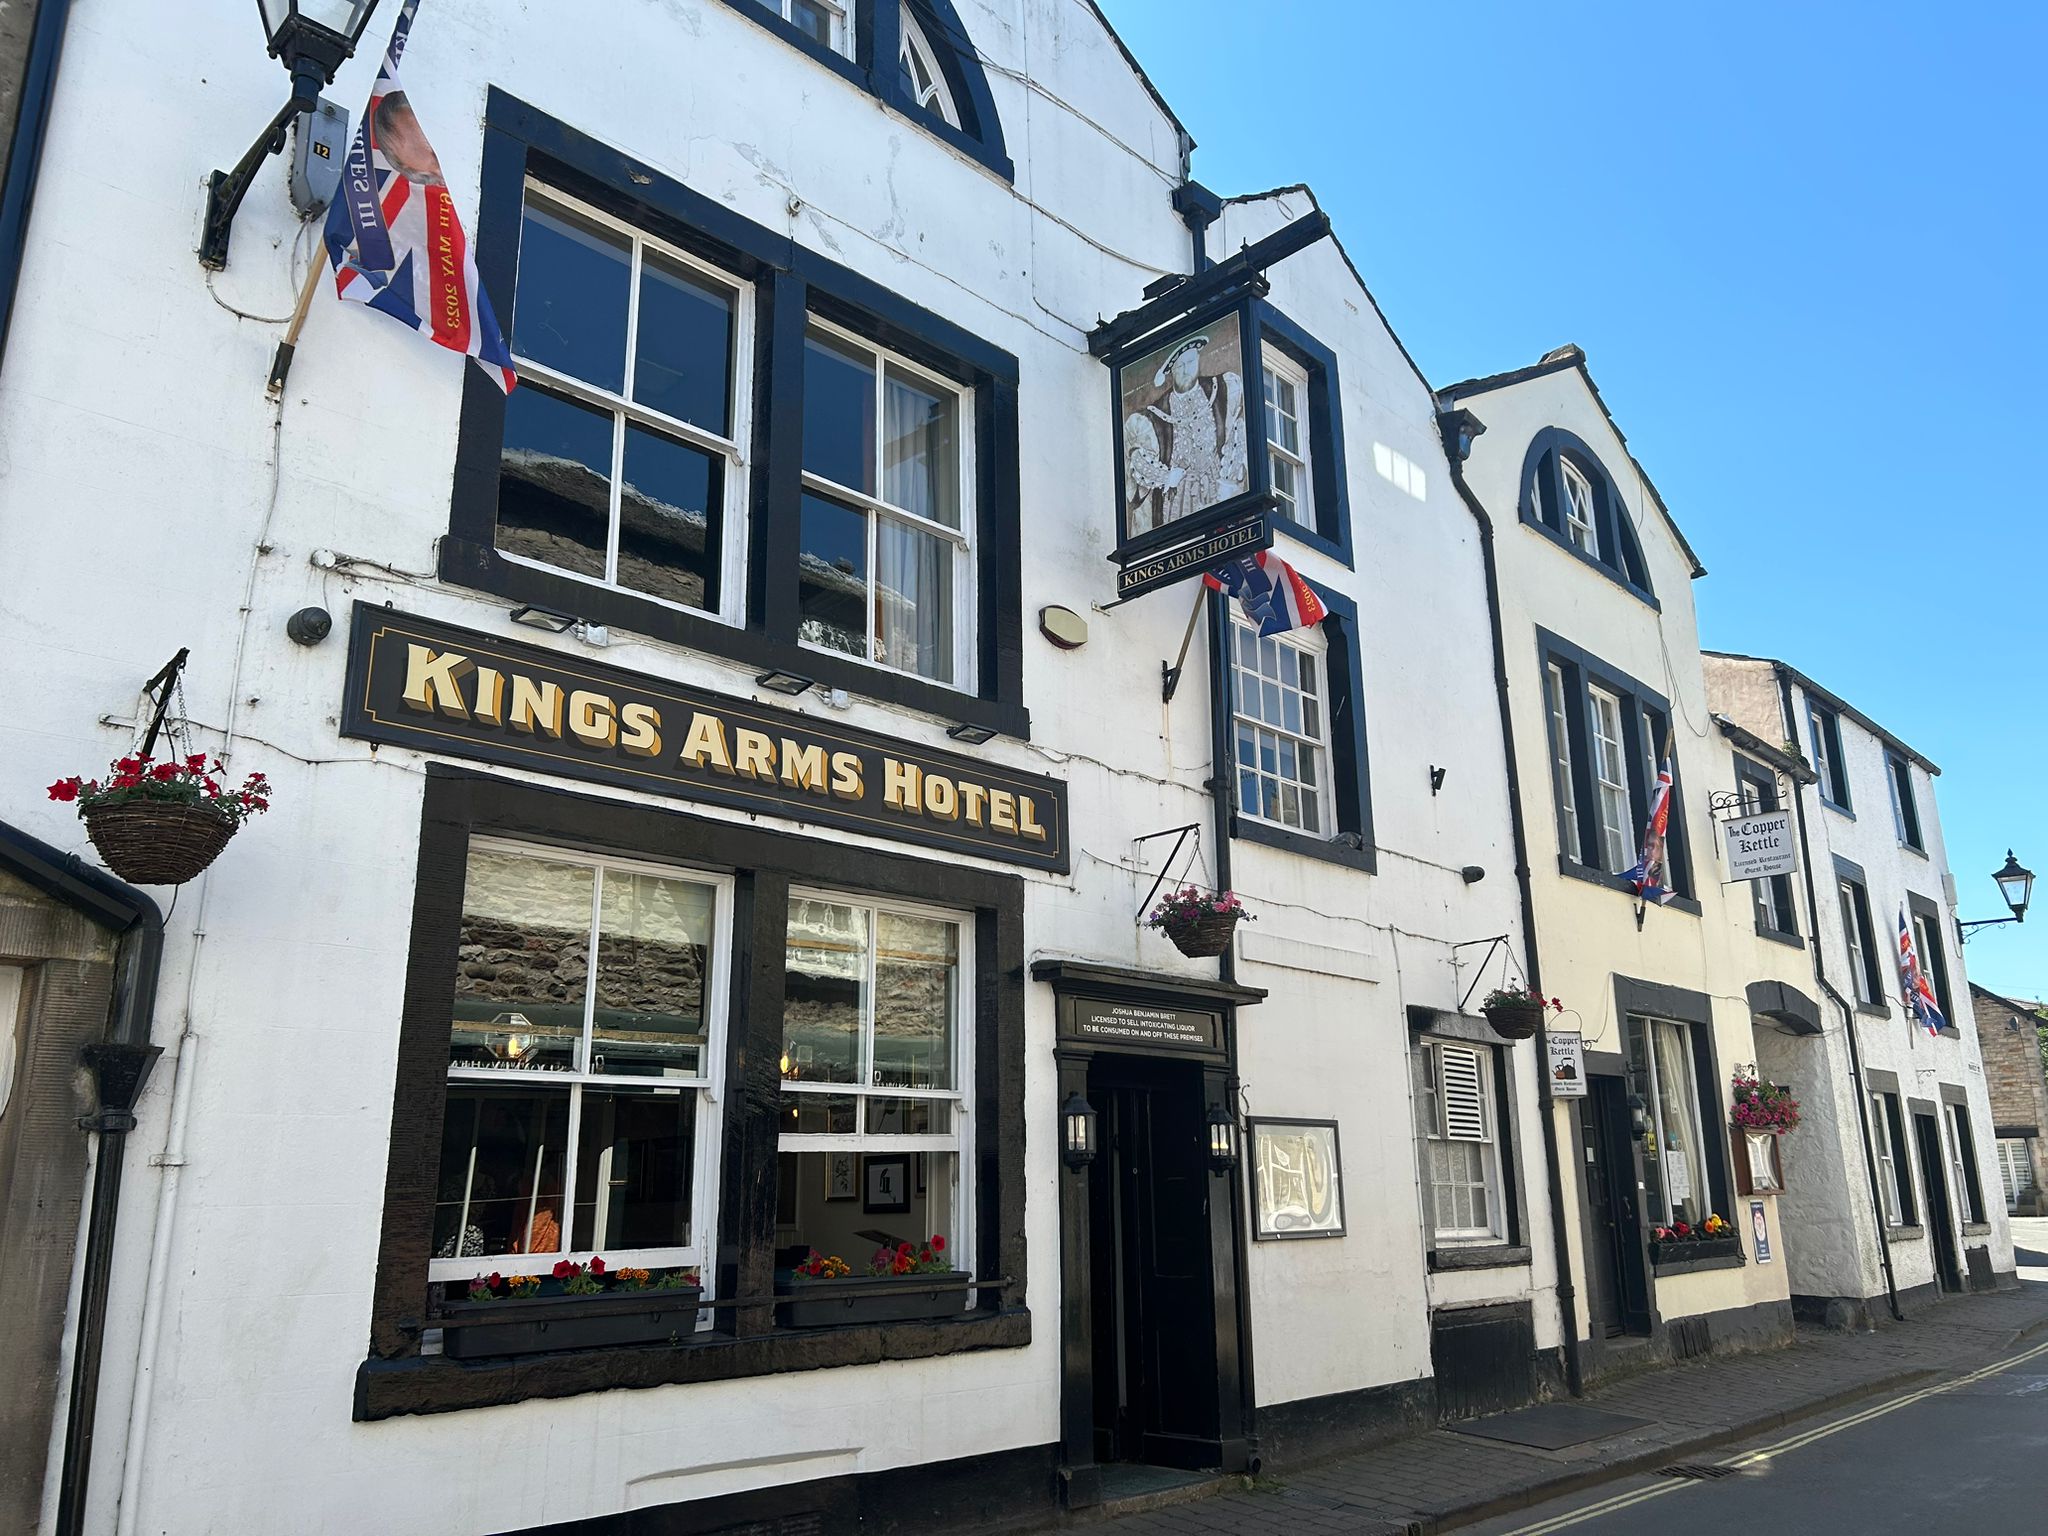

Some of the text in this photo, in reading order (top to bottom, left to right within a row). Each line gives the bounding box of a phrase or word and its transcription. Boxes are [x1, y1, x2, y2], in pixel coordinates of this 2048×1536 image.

[316, 144, 329, 158] 12
[1124, 528, 1257, 587] KINGS ARMS HOTEL
[402, 643, 1047, 843] KINGS ARMS HOTEL
[1728, 819, 1785, 838] The Copper
[1739, 836, 1780, 853] Kettle
[1111, 1007, 1176, 1020] JOSHUA BENJAMIN BRETT
[1091, 1015, 1118, 1025] LICENSED
[1126, 1018, 1140, 1027] SELL
[1140, 1020, 1176, 1030] INTOXICATING
[1176, 1024, 1196, 1032] LIQUOR
[1083, 1024, 1091, 1032] TO
[1092, 1025, 1100, 1033] BE
[1100, 1026, 1130, 1036] CONSUMED
[1140, 1030, 1152, 1038] AND
[1163, 1032, 1180, 1040] THESE
[1180, 1033, 1204, 1042] PREMISES
[1552, 1036, 1579, 1046] Copper
[1550, 1046, 1575, 1056] Kettle
